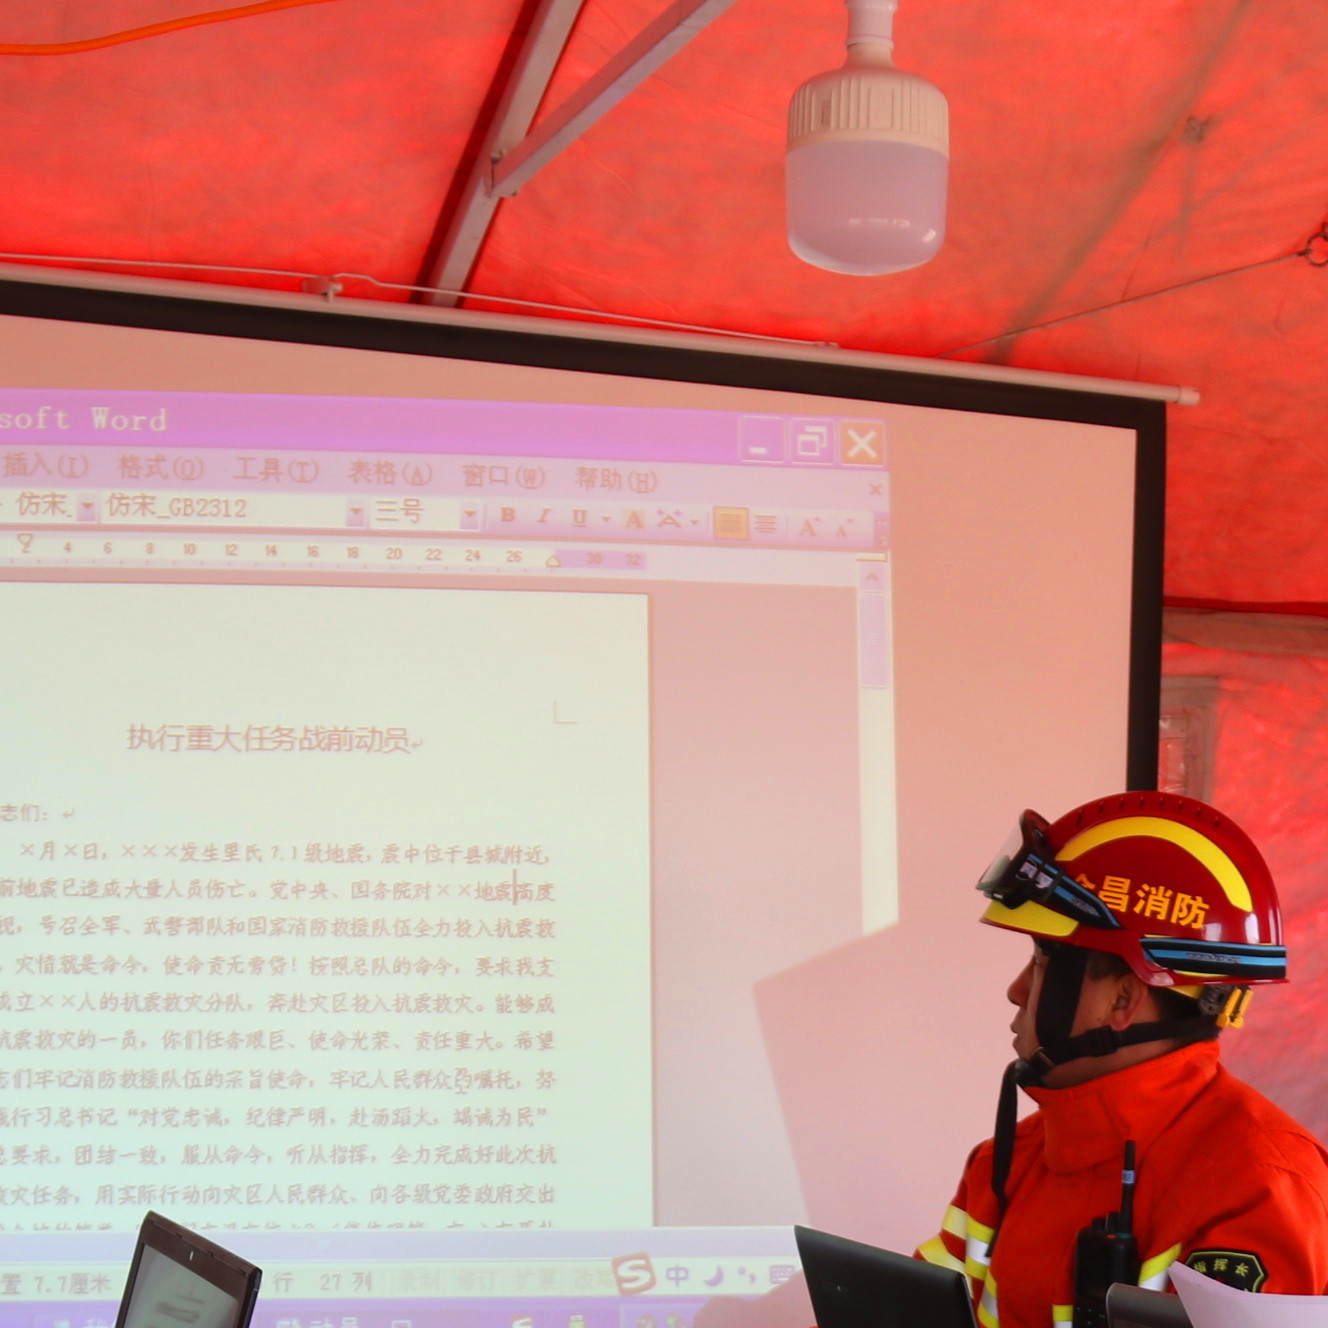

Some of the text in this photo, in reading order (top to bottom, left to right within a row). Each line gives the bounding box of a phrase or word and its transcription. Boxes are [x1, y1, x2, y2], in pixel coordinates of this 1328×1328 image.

[90, 406, 168, 432] Word
[1, 451, 89, 480] 插入(I)
[233, 456, 320, 485] 工具(T)
[347, 459, 434, 488] 表格(A)
[462, 463, 547, 490] 窗口(W)
[574, 466, 658, 495] 帮助(H)
[105, 491, 247, 520] 仿宋_GB2312
[374, 498, 425, 525] 三号
[183, 543, 197, 556] 10
[224, 543, 238, 557] 12
[264, 544, 278, 558] 14
[306, 545, 320, 559] 16
[346, 545, 360, 560] 18
[386, 546, 403, 561] 20
[425, 547, 442, 561] 22
[465, 548, 481, 562] 24
[506, 549, 523, 563] 26
[126, 722, 412, 754] 执行重大任务战前动员
[271, 1271, 294, 1293] 行
[319, 1274, 342, 1291] 27
[351, 1271, 372, 1293] 列
[665, 1263, 690, 1288] 中
